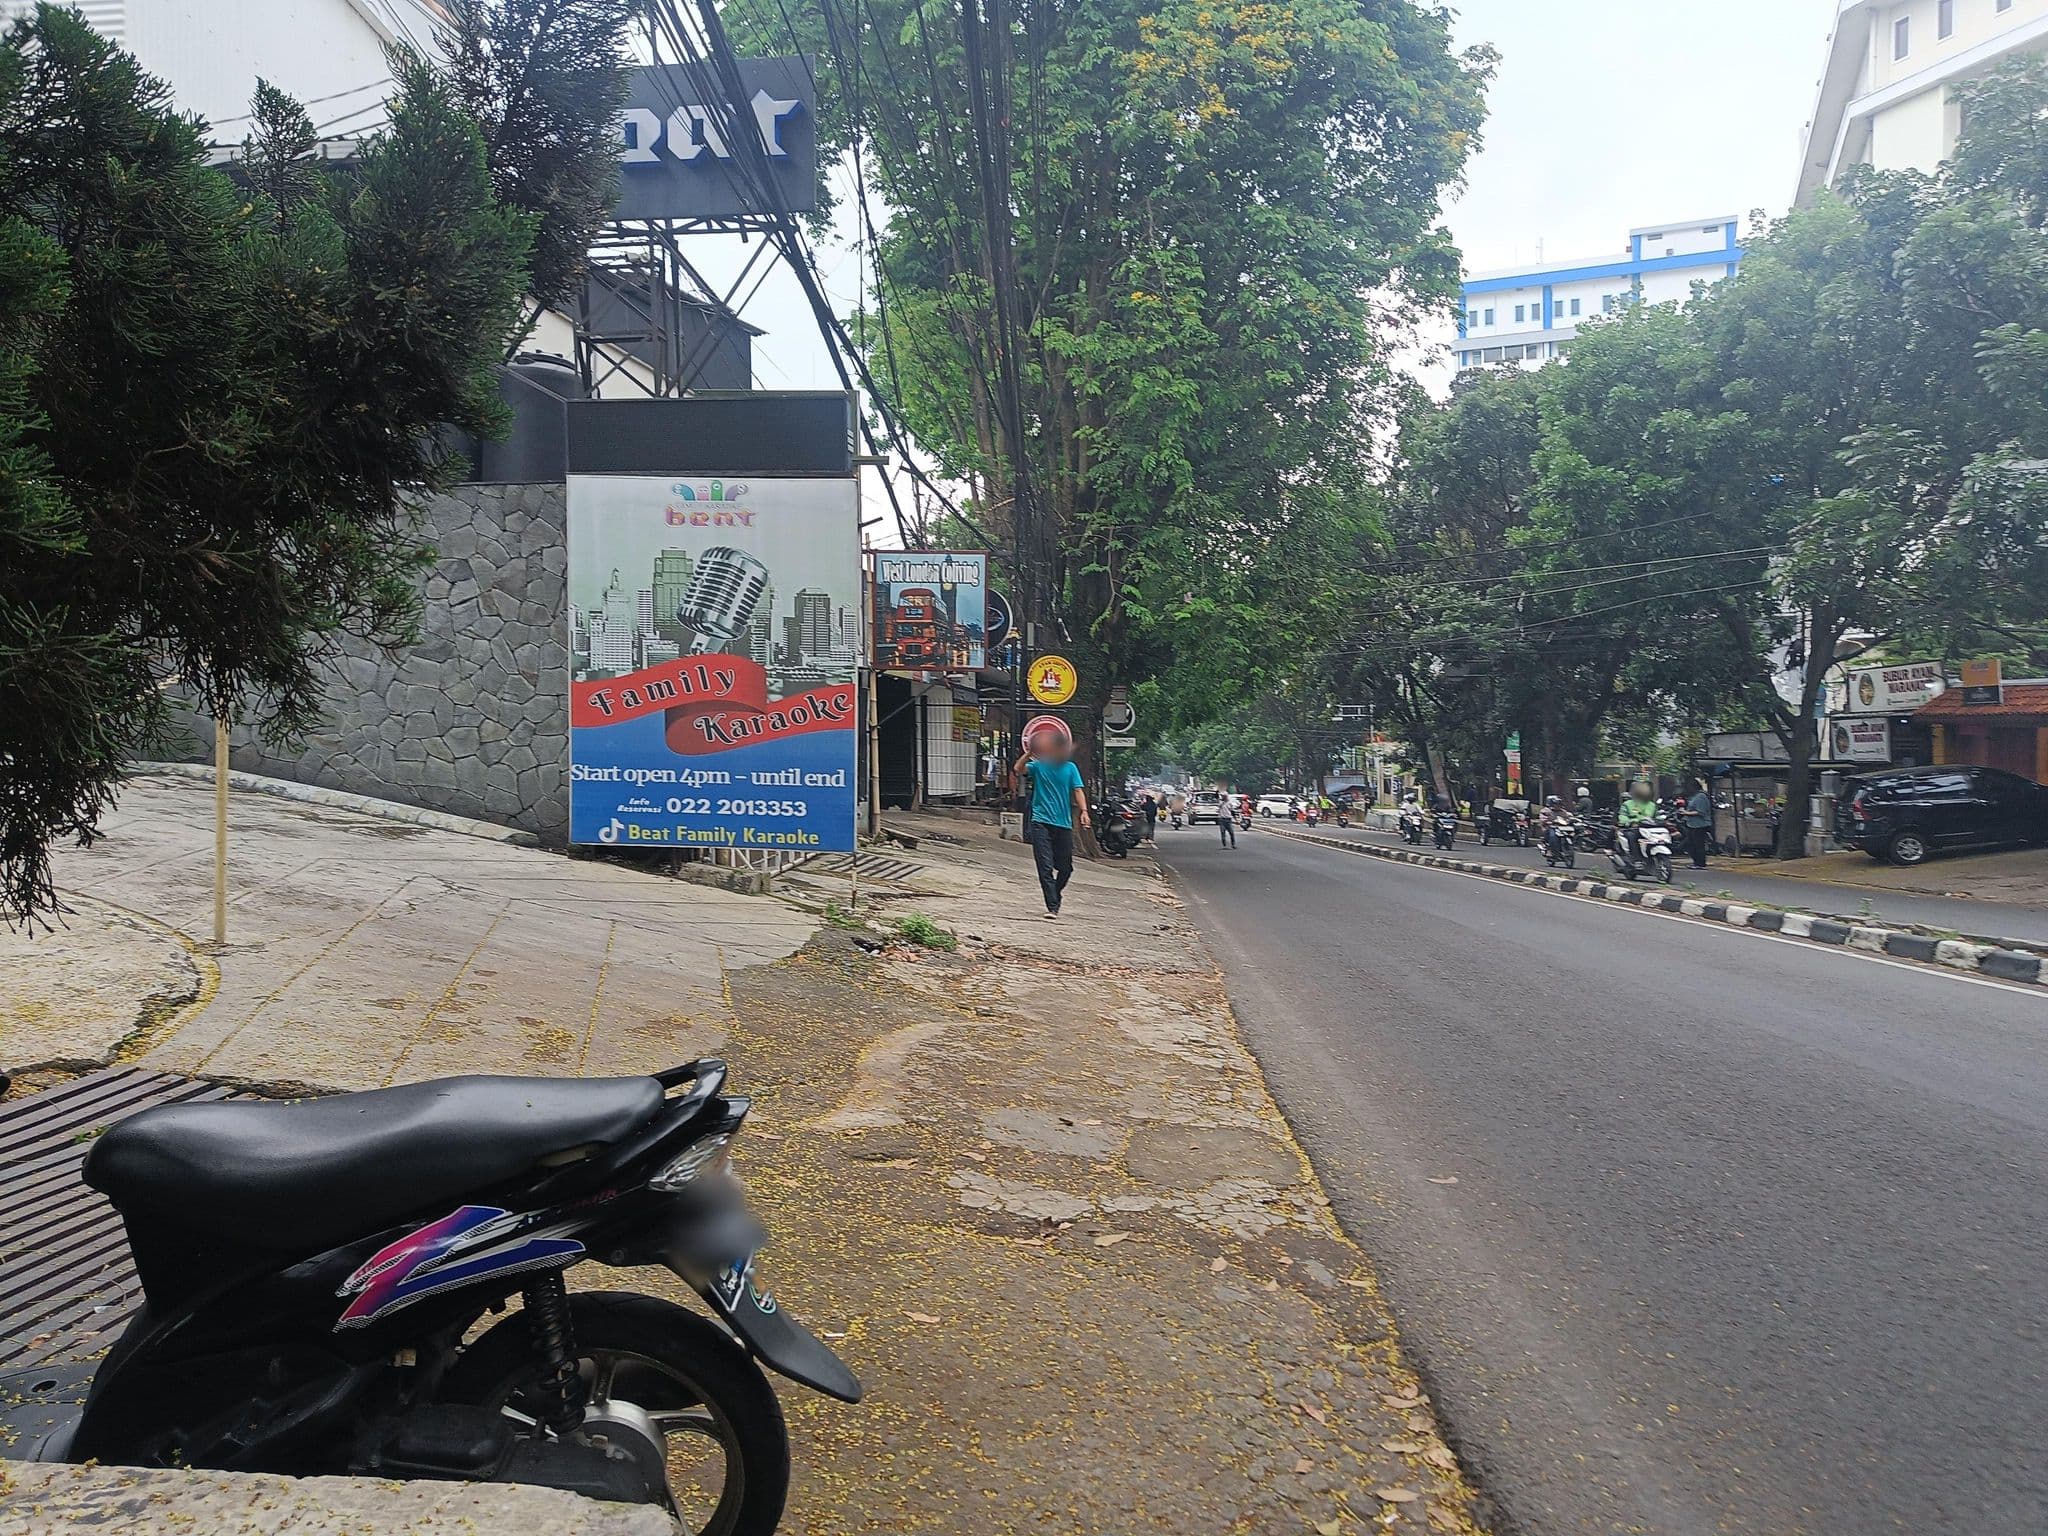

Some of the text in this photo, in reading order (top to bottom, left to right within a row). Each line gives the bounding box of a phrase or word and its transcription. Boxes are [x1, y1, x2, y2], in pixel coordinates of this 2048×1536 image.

[881, 560, 904, 583] West
[904, 560, 940, 583] London
[588, 664, 736, 717] Family
[694, 692, 854, 745] Karaoke
[571, 764, 621, 782] Start
[624, 769, 677, 787] open
[679, 768, 730, 788] 4pm
[751, 768, 801, 786] until
[804, 769, 846, 788] end
[666, 797, 807, 817] 022 2013353
[628, 824, 819, 845] Beat Family Karaoke
